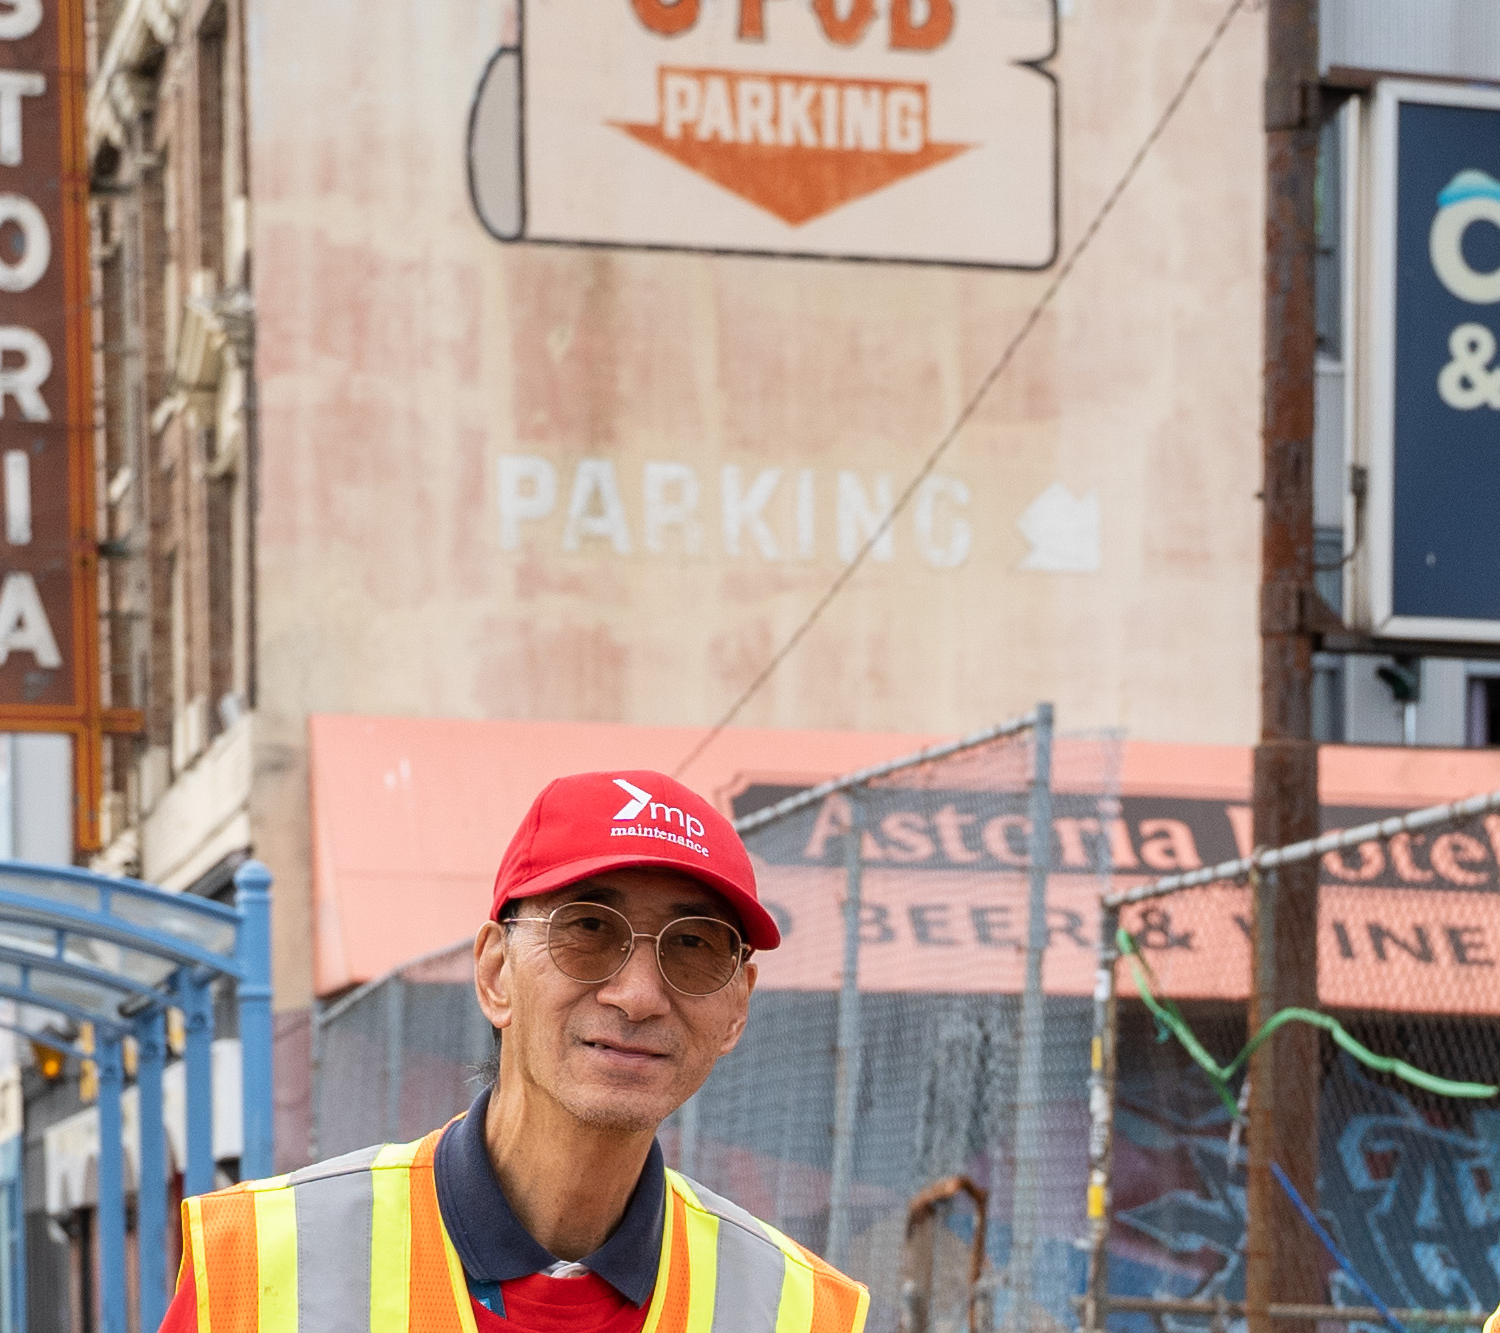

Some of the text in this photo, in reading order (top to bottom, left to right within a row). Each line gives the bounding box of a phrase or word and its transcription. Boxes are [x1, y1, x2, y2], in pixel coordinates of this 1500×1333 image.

[663, 74, 924, 153] PARKING
[498, 453, 973, 568] PARKING
[610, 823, 711, 858] maintenance
[649, 801, 705, 838] mp
[803, 793, 1203, 870] Astoria
[859, 903, 1093, 947] BEER
[1136, 907, 1195, 951] &
[1233, 913, 1495, 968] INE
